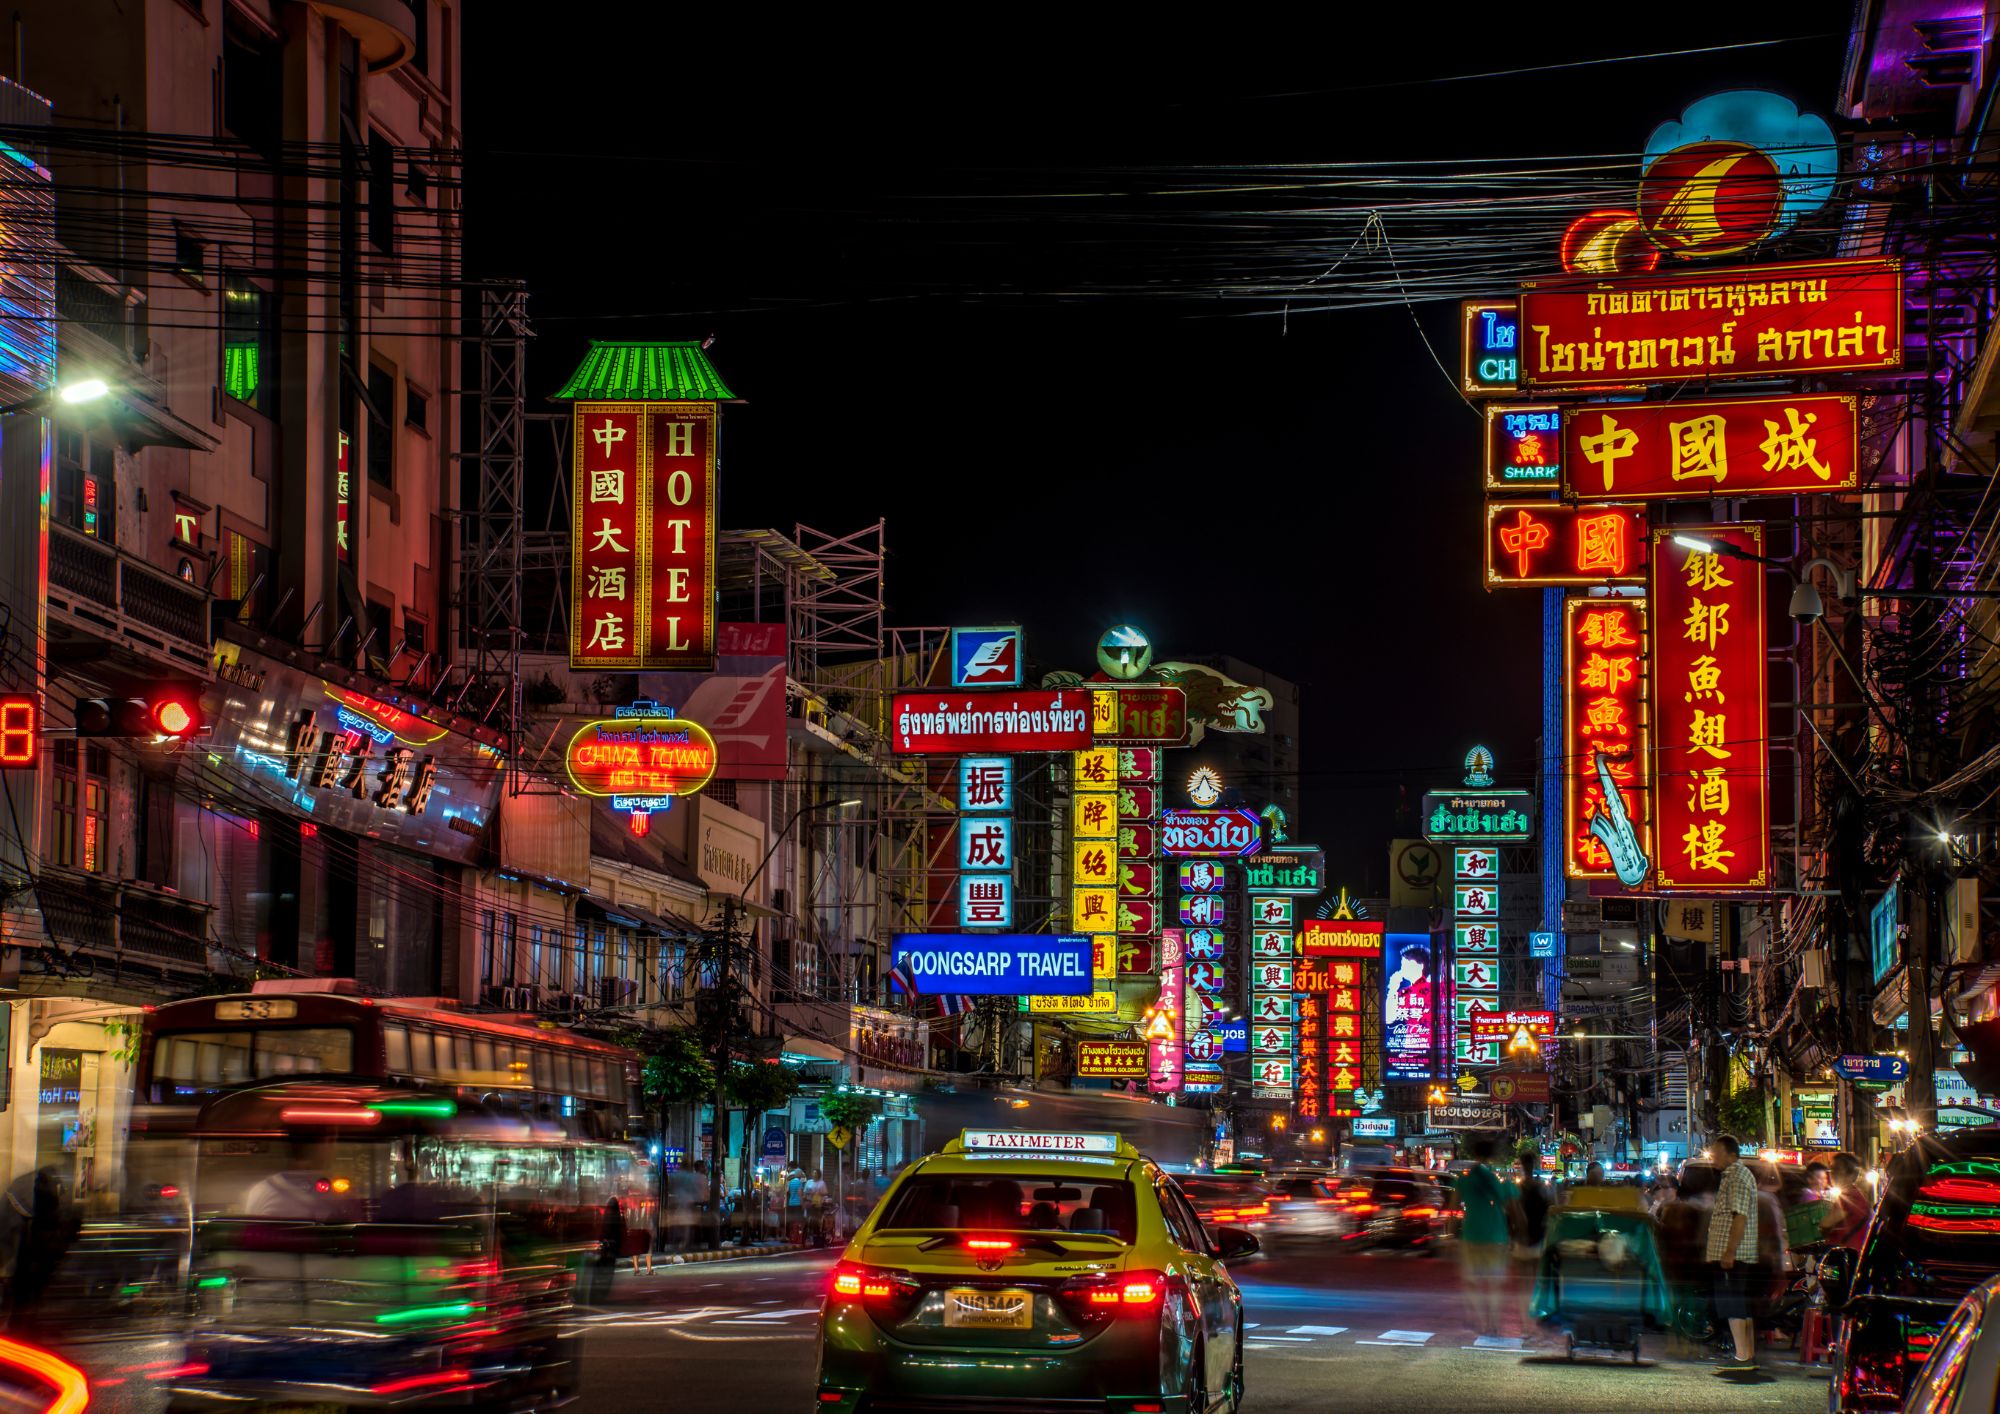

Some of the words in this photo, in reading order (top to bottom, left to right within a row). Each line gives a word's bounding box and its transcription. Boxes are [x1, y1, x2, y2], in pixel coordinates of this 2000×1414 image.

[1480, 359, 1516, 380] CH
[1532, 321, 1736, 373] ไชน่าทาวน์
[1757, 312, 1888, 363] สกาล่า
[1580, 408, 1831, 492] 中國城
[586, 418, 631, 651] 中國大酒店
[665, 422, 696, 651] HOTEL
[1500, 510, 1625, 577] 中國
[899, 693, 1086, 748] รุ่งทรัพย์การท่องเที่ยว
[1681, 547, 1735, 875] 銀都魚翅酒樓
[577, 746, 640, 767] CHINA
[650, 747, 708, 768] TOWN
[966, 766, 1006, 922] 振成豐
[1017, 952, 1086, 977] TRAVEL
[1262, 903, 1284, 1083] 和成興大金行
[1161, 971, 1176, 1080] 北京仁堂
[1843, 1058, 1881, 1068] เยาวราช
[1892, 1061, 1902, 1075] 2
[988, 1134, 1086, 1149] TAXI-METER
